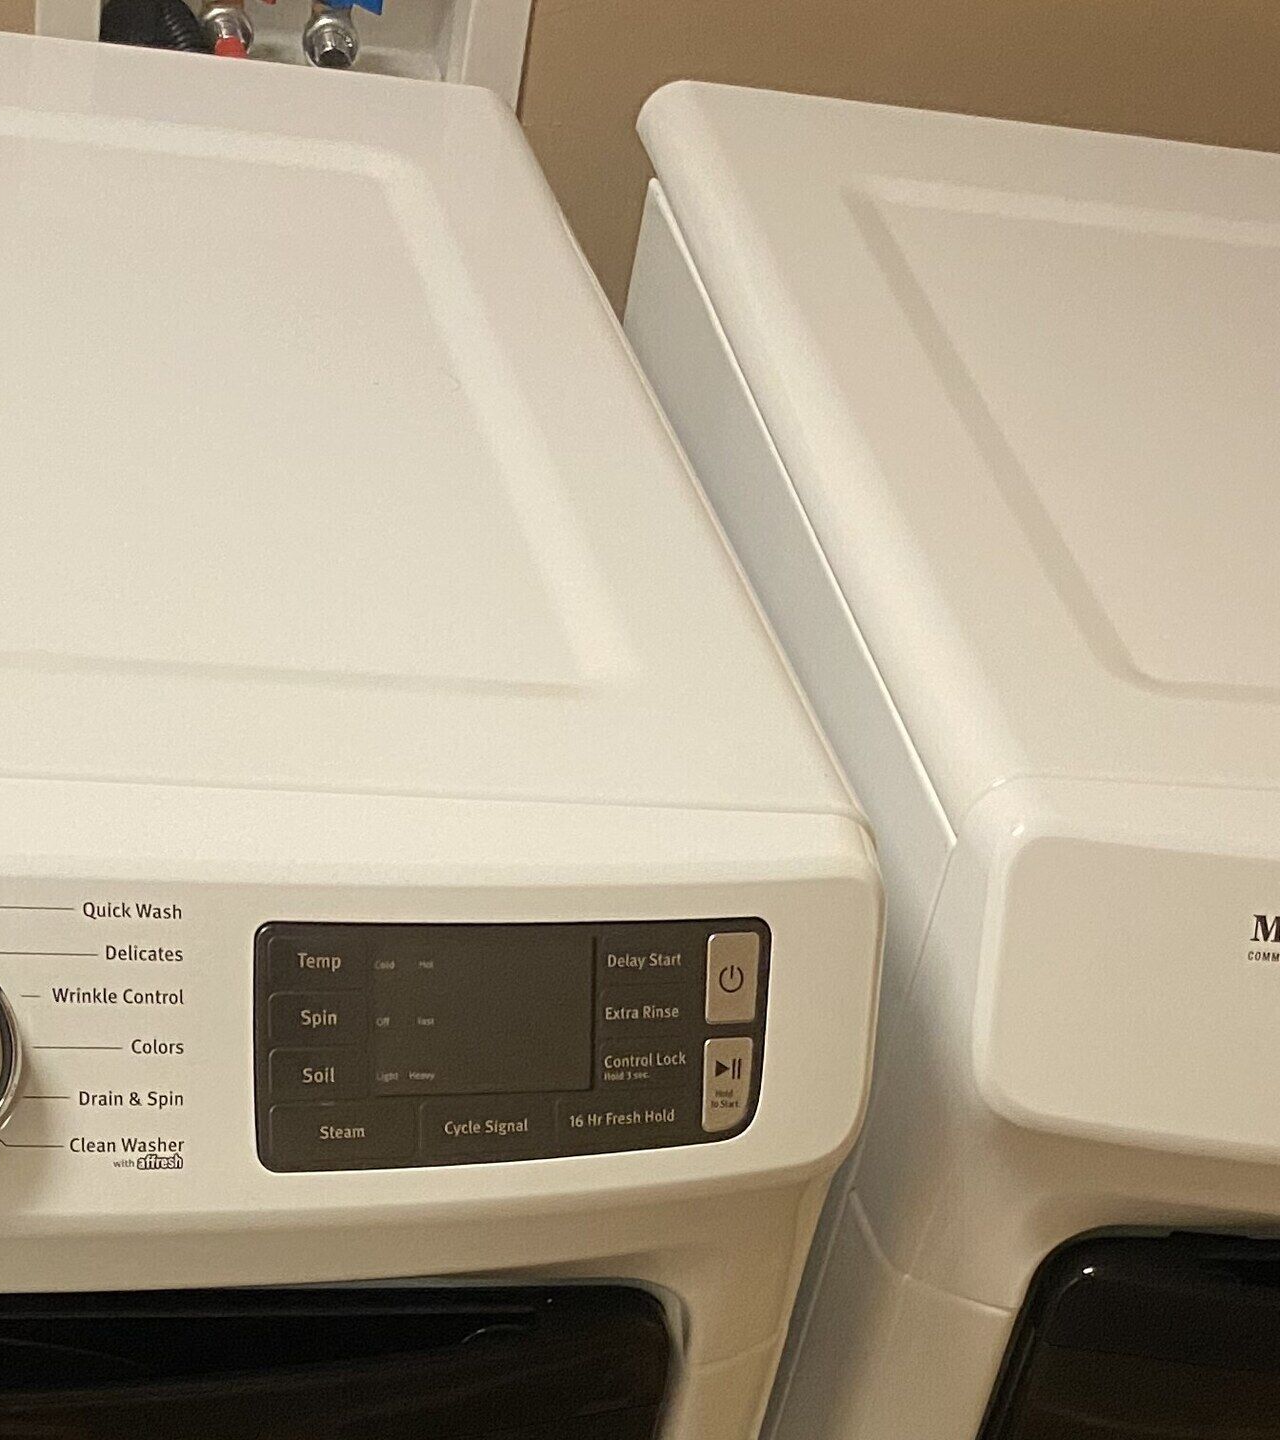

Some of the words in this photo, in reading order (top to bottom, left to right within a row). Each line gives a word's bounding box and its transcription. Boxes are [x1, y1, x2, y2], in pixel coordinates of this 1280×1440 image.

[83, 901, 131, 921] Quick
[136, 902, 183, 920] Wash
[105, 945, 184, 963] Delicates
[297, 953, 342, 972] Temp
[607, 954, 644, 971] Delay
[648, 952, 681, 968] Start
[52, 987, 118, 1006] Wrinkle
[123, 987, 184, 1006] Control
[301, 1009, 337, 1029] Spin
[605, 1005, 638, 1021] Extra
[642, 1004, 679, 1020] Rinse
[131, 1038, 184, 1056] Colors
[604, 1053, 653, 1069] Control
[656, 1051, 686, 1067] Lock
[302, 1066, 336, 1084] Soil
[79, 1090, 124, 1108] Drain
[129, 1091, 143, 1107] &
[148, 1090, 184, 1111] Spin
[445, 1119, 480, 1136] Cycle
[485, 1116, 528, 1136] Signal
[570, 1115, 583, 1129] 16
[587, 1113, 602, 1128] Hr
[606, 1110, 641, 1126] Fresh
[645, 1108, 675, 1123] Hold
[320, 1125, 365, 1140] Steam
[70, 1137, 116, 1153] Clean
[121, 1137, 184, 1153] Washer
[113, 1159, 135, 1168] with
[137, 1153, 183, 1170] affresh
